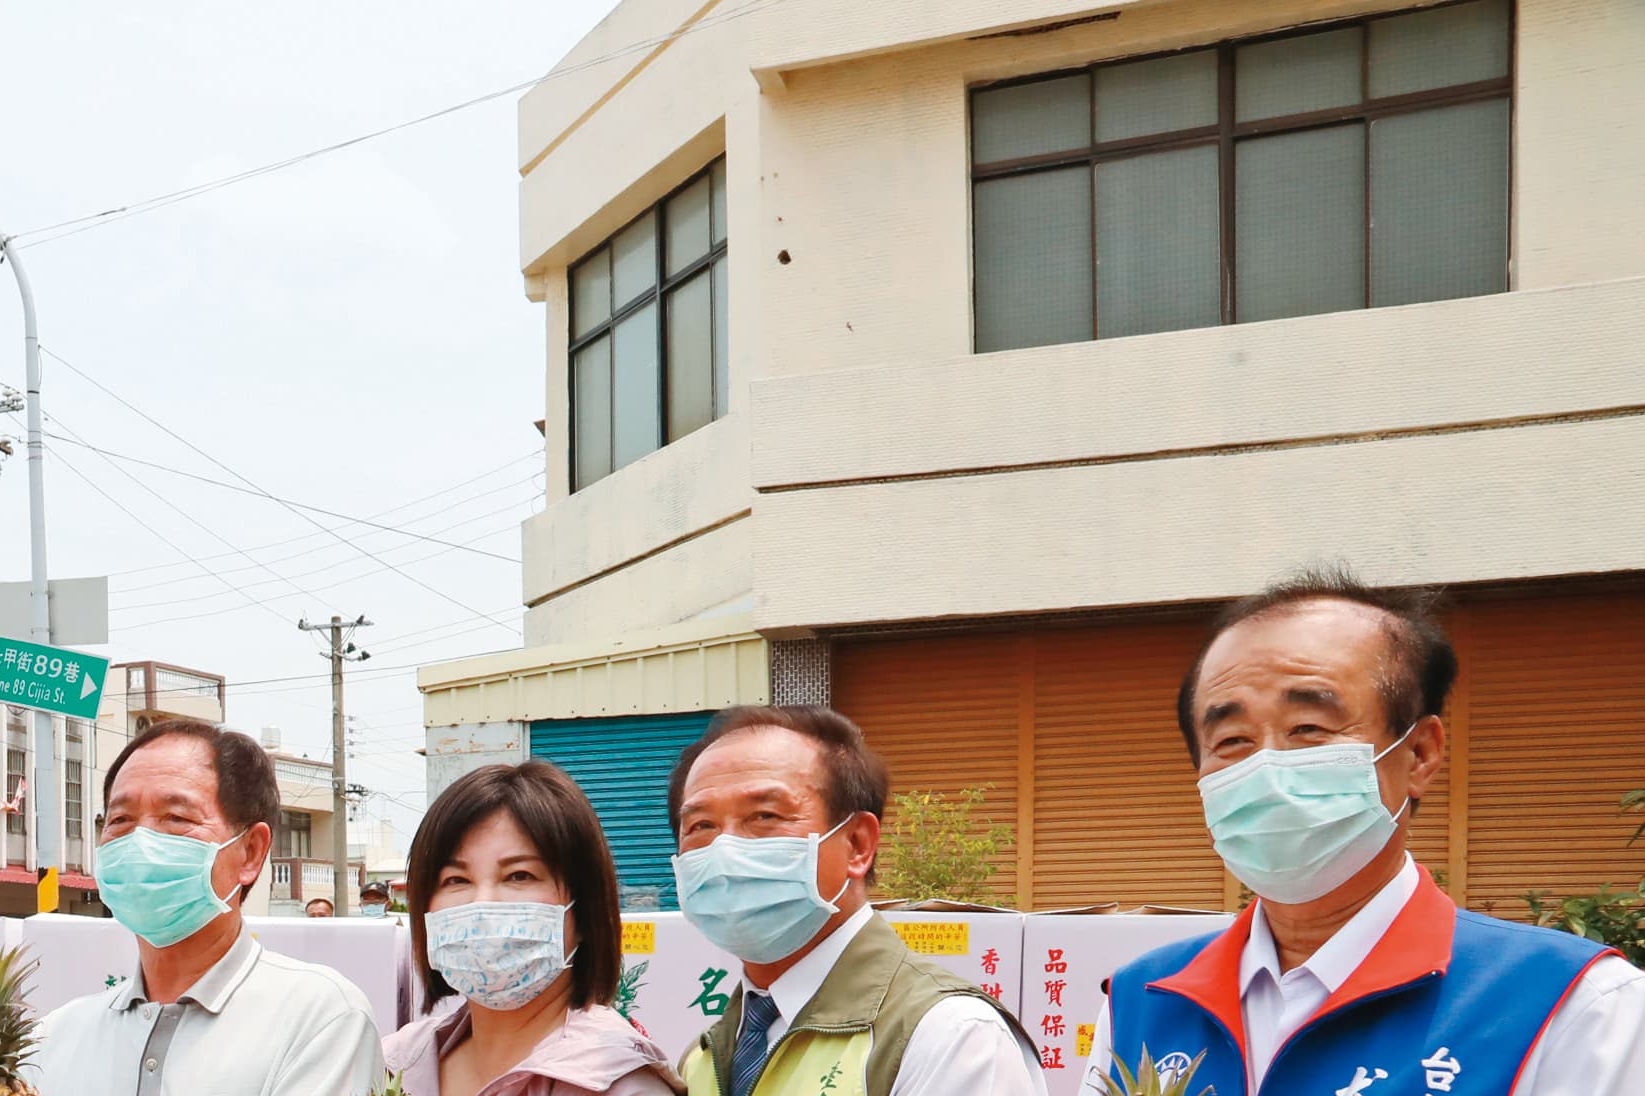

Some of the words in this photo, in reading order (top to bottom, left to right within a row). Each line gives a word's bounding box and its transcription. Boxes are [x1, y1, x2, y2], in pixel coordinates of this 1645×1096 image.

[12, 678, 26, 696] 89
[27, 681, 51, 703] Cijia
[52, 687, 66, 705] St.
[687, 967, 730, 1016] 名
[1041, 949, 1067, 1069] 品質保証
